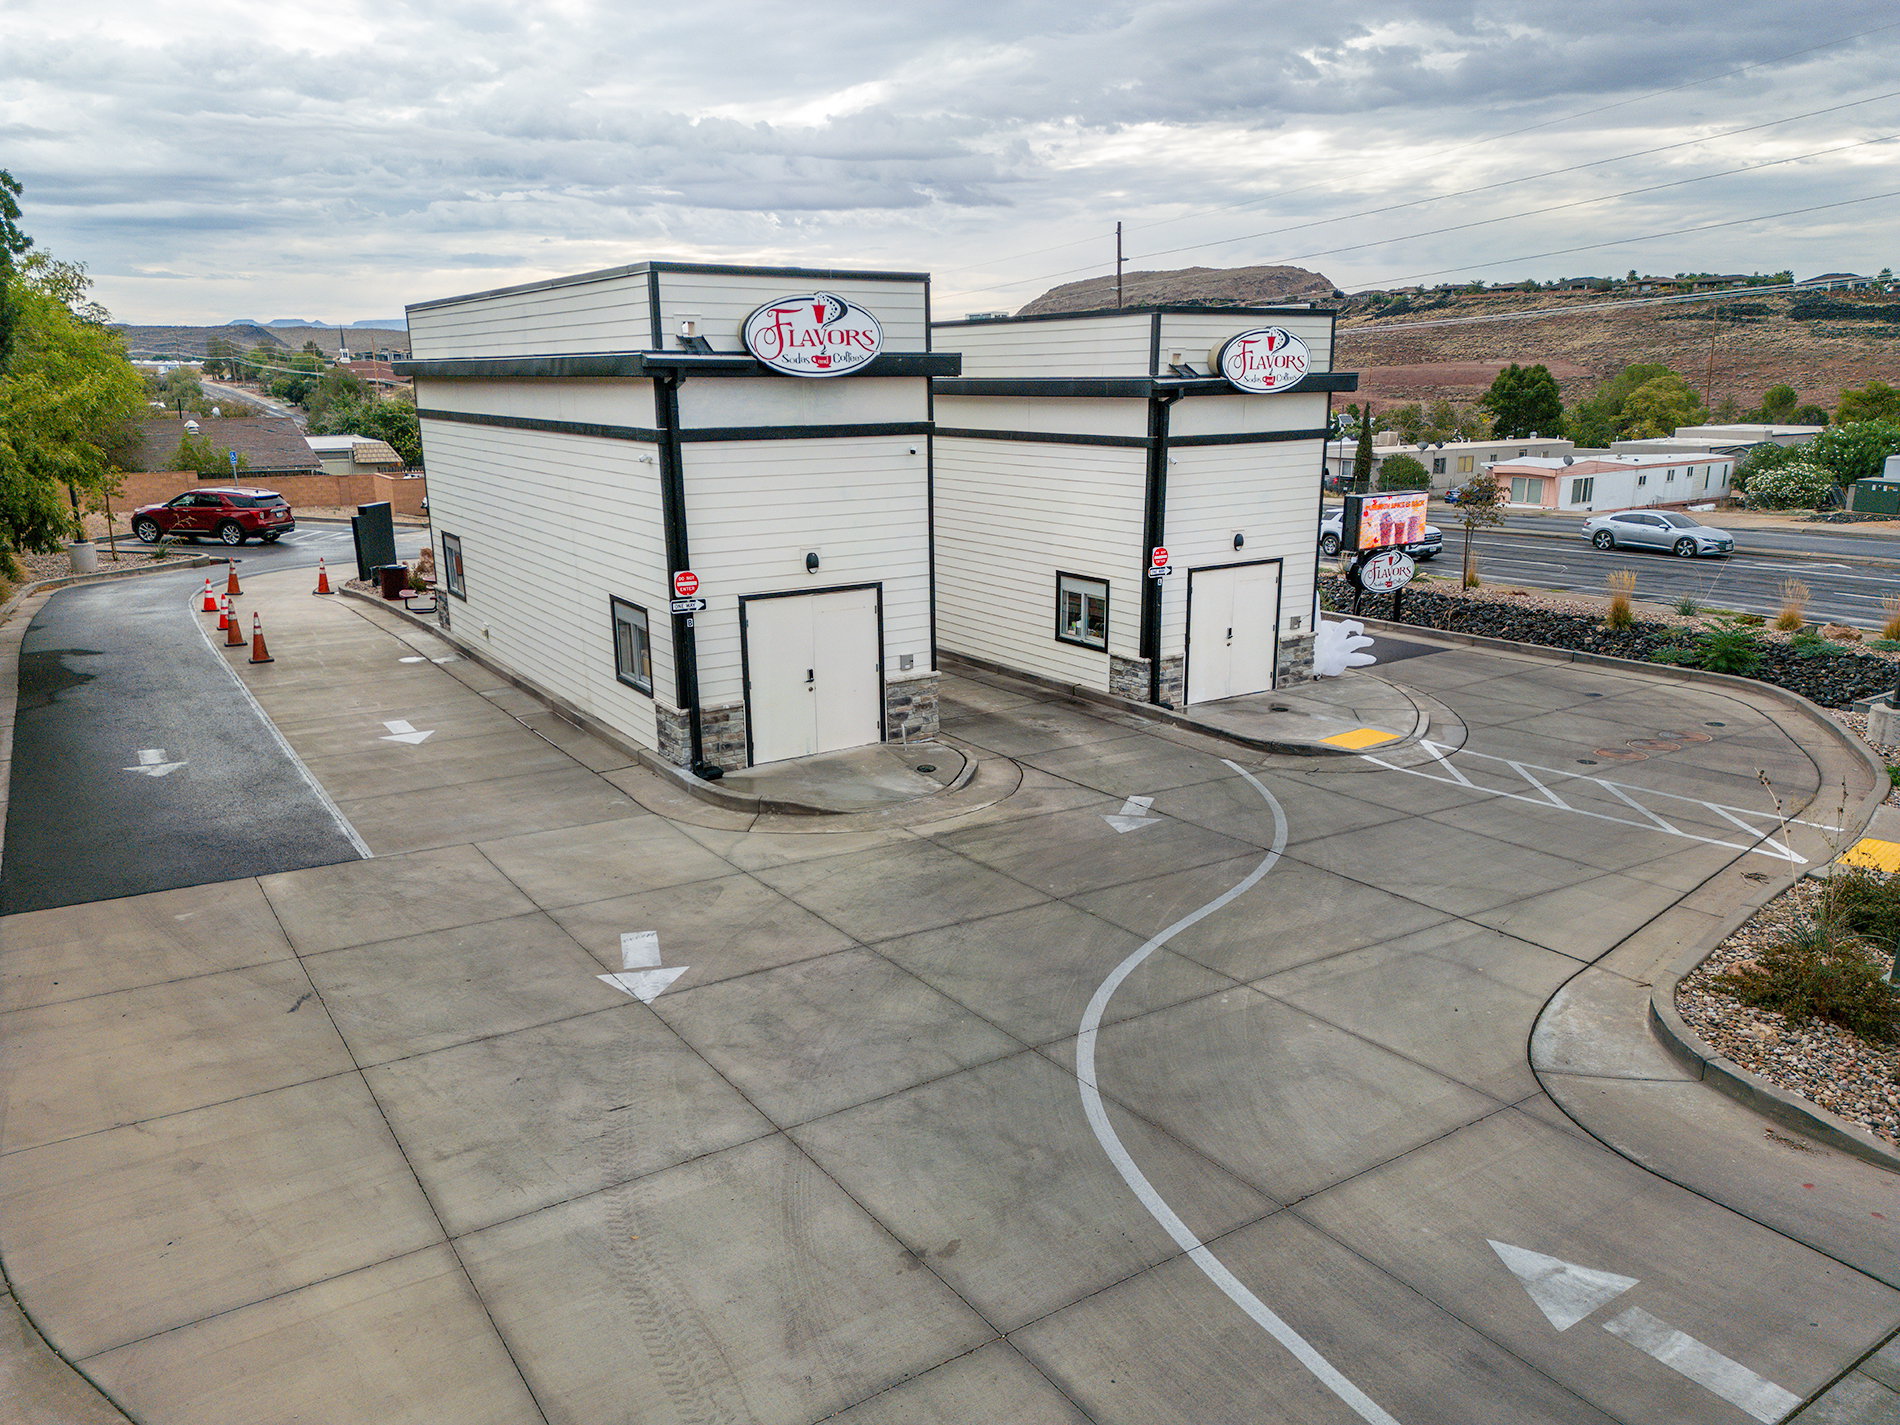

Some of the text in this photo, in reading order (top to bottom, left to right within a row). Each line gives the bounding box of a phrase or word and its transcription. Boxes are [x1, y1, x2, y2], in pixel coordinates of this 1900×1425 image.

[754, 308, 879, 361] FLAVORS
[782, 354, 810, 364] Sodas
[832, 352, 864, 363] Coffees
[1227, 340, 1306, 380] FLAVORS
[1364, 560, 1411, 585] FLAVORS
